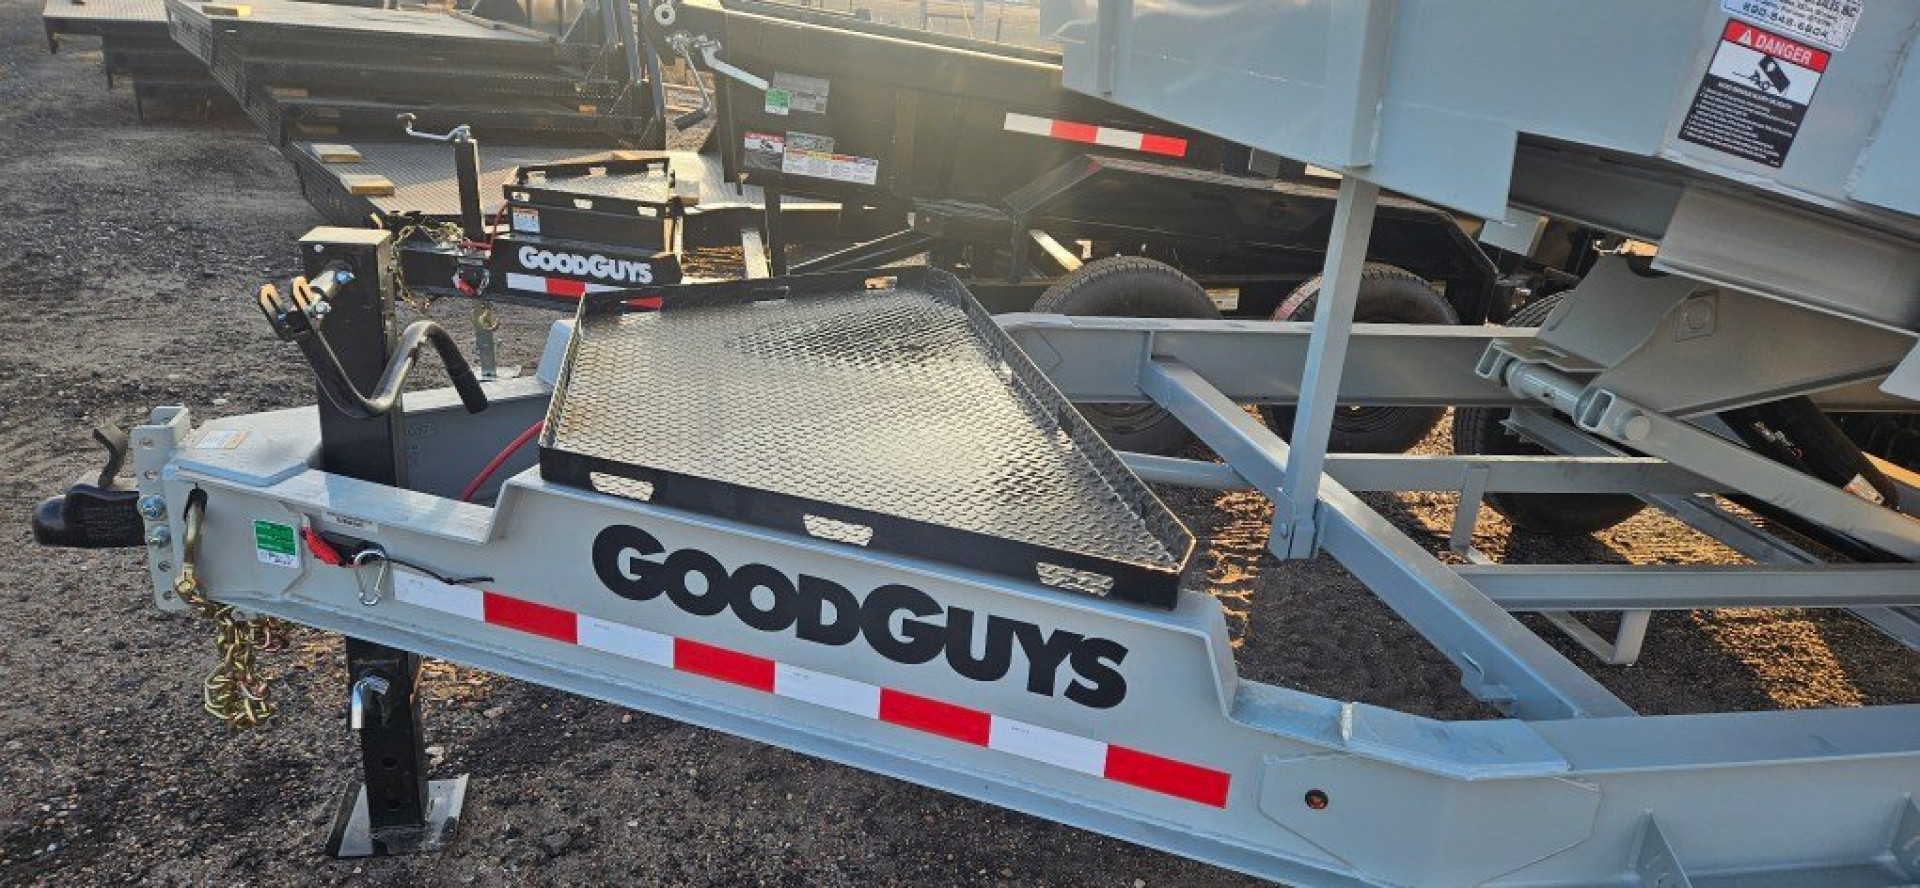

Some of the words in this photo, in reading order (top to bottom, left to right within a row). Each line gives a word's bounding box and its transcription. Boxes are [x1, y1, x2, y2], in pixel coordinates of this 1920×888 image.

[1757, 33, 1812, 65] DANGER
[518, 246, 653, 284] GOODGUYS
[592, 524, 1128, 709] GOODGUYS
